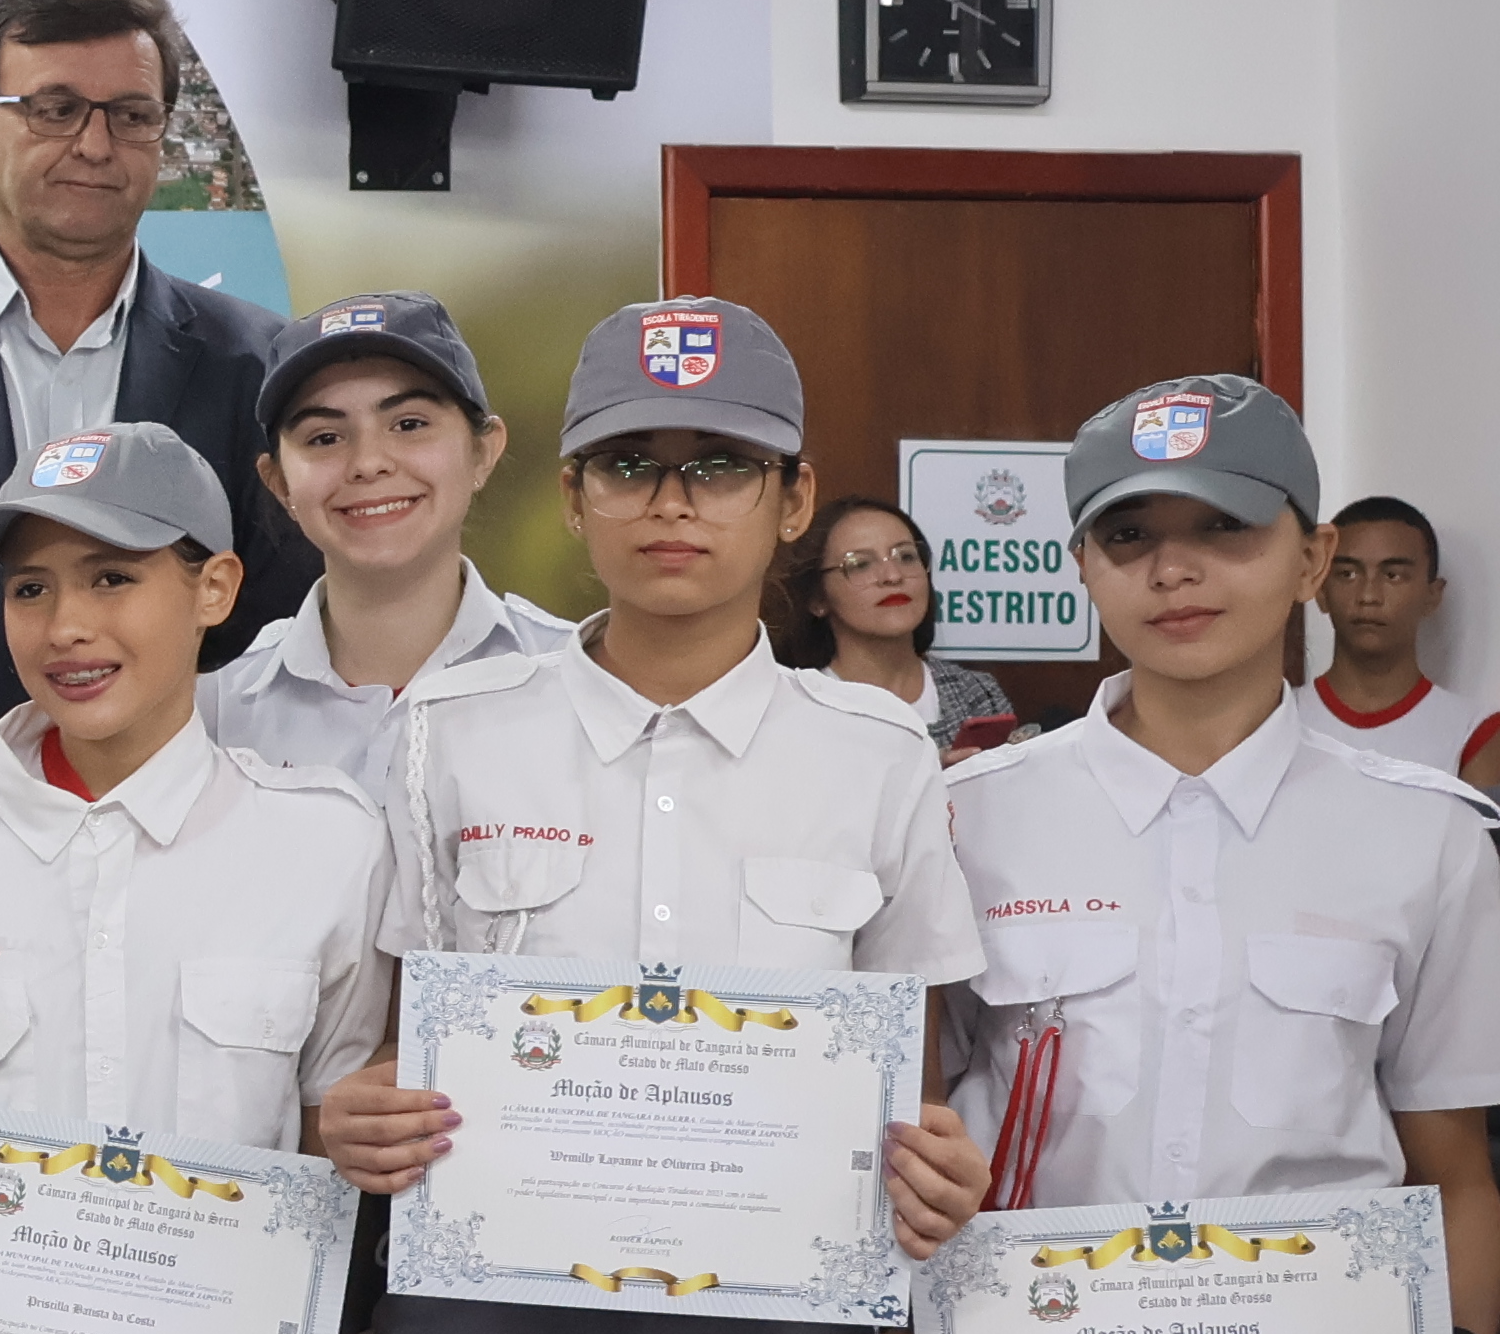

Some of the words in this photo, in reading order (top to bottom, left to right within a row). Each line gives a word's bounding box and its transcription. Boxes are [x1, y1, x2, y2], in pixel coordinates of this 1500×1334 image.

[643, 313, 672, 326] ESCOLA
[673, 313, 719, 324] TIRADENTES
[938, 539, 1063, 574] ACESSO
[512, 826, 571, 842] PRADO
[985, 898, 1071, 922] THASSYLA
[551, 1079, 612, 1102] Moção
[619, 1084, 638, 1100] de
[646, 1084, 732, 1106] Aplausos
[11, 1226, 67, 1250] Moção
[73, 1235, 91, 1253] de
[97, 1239, 177, 1267] Aplausos
